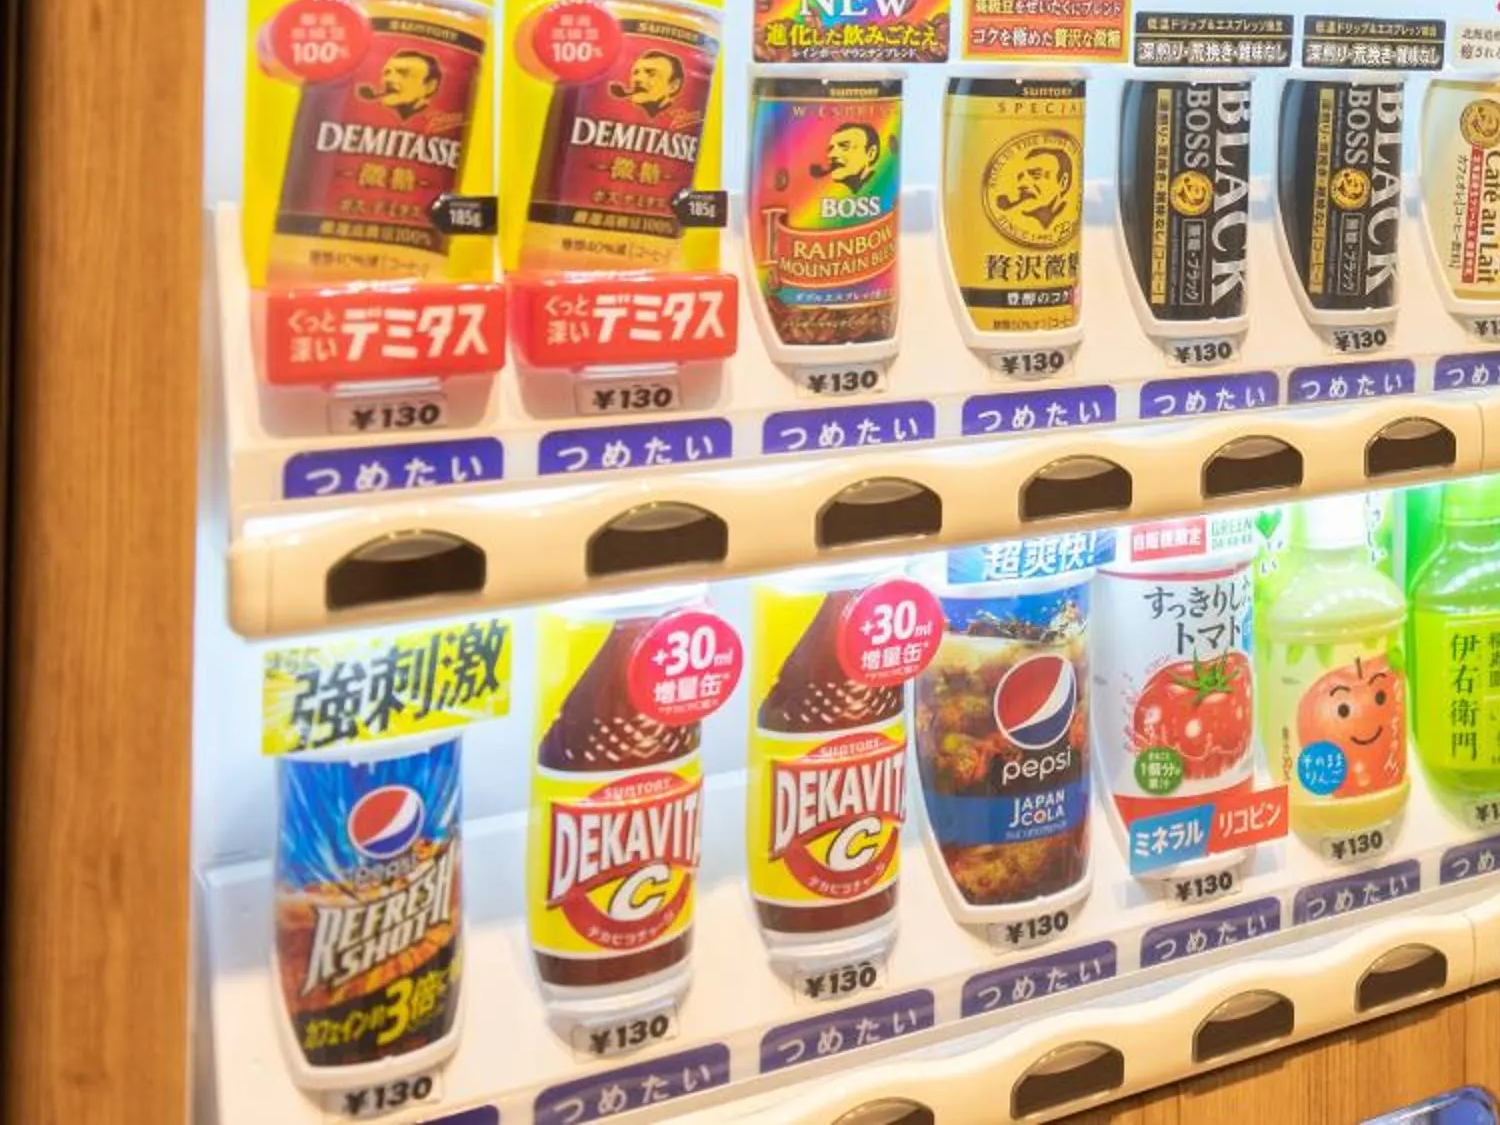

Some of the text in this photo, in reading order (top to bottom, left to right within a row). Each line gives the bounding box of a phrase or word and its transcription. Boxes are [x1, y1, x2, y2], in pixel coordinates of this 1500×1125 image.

[766, 23, 941, 49] 進化した飲みごたえ
[997, 100, 1081, 115] SPECIA
[1344, 84, 1372, 167] BOSS
[315, 121, 461, 169] DEMITASSE
[570, 116, 698, 164] DEMITASSE
[1184, 83, 1213, 170] BOSS
[688, 200, 716, 218] 185g
[821, 195, 882, 220] BOSS
[1211, 85, 1251, 306] BLACK
[1364, 86, 1403, 297] BLACK
[449, 207, 482, 228] 185g
[1481, 208, 1498, 236] au
[792, 227, 894, 260] RAINBOW
[778, 255, 871, 280] MOUNTAIN
[1477, 242, 1500, 284] Lait
[341, 302, 489, 362] デミタス
[547, 318, 592, 347] 深い
[592, 290, 726, 344] デミタス
[289, 334, 338, 363] 深い
[1174, 340, 1234, 365] ¥130
[1333, 328, 1388, 353] ¥130
[1000, 350, 1065, 375] ¥130
[592, 383, 673, 411] ¥130
[806, 369, 880, 395] ¥130
[1153, 385, 1266, 416] つめたい
[1300, 374, 1403, 399] つめたい
[350, 402, 440, 431] ¥130
[780, 416, 919, 450] つめたい
[977, 400, 1102, 433] つめたい
[556, 433, 714, 472] つめたい
[306, 453, 484, 496] つめたい
[983, 531, 1098, 581] 超爽快!
[859, 599, 933, 647] +30ml
[1176, 617, 1242, 655] トマト
[650, 625, 733, 678] +30ml
[860, 643, 921, 673] 増量缶
[285, 618, 509, 753] 強刺激
[651, 671, 722, 706] 増量缶
[1450, 632, 1481, 763] 伊右衛門
[1001, 746, 1073, 786] pepsi
[602, 776, 672, 800] SUNTORY
[1010, 788, 1067, 828] JAPAN
[1020, 806, 1066, 827] COLA
[828, 816, 883, 872] C
[1134, 802, 1282, 857] ミネラル リコピン
[1330, 830, 1384, 860] ¥130
[607, 864, 672, 921] C
[1174, 871, 1234, 902] ¥130
[1307, 874, 1408, 918] つめたい
[304, 849, 457, 994] REFRESH
[1003, 910, 1070, 944] ¥130
[1155, 915, 1267, 961] つめたい
[804, 966, 878, 999] ¥130
[977, 959, 1103, 1008] つめたい
[586, 1015, 670, 1052] ¥130
[778, 1009, 918, 1064] つめたい
[342, 1076, 434, 1113] ¥130
[554, 1065, 713, 1123] つめたい
